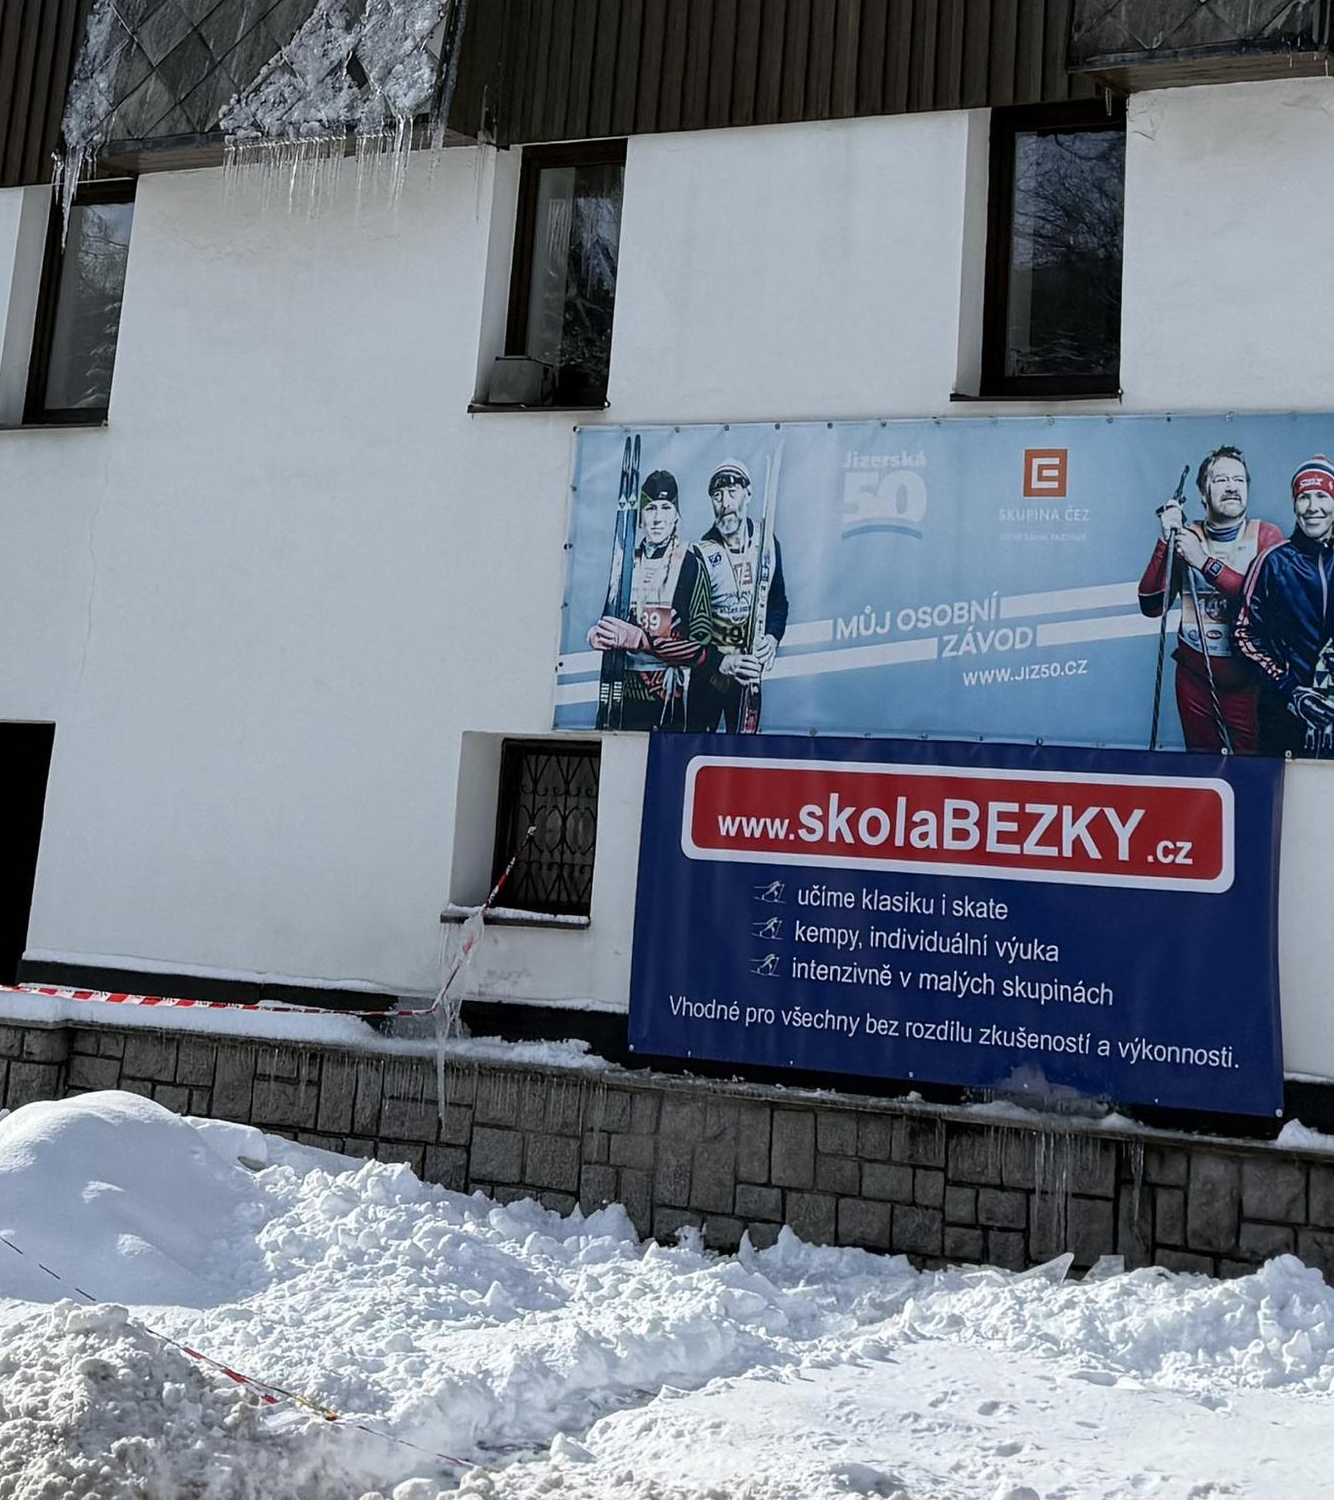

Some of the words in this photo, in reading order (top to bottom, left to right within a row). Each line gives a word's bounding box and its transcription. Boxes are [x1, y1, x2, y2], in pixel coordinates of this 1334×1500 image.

[843, 449, 927, 468] Jizerská
[842, 470, 928, 524] 50
[998, 507, 1060, 522] SKUPINA
[1064, 504, 1091, 522] ČEZ
[835, 605, 892, 640] MŮJ
[897, 591, 1000, 632] OSOBNÍ
[942, 627, 1033, 658] ZÁVOD
[962, 659, 1088, 687] WWW.JIZ50.CZ
[797, 885, 855, 909] učíme
[862, 888, 934, 915] klasiku
[941, 894, 947, 916] i
[952, 894, 1009, 920] skate
[794, 920, 863, 951] kempy,
[869, 926, 988, 957] individuální
[995, 936, 1060, 964] výuka
[791, 957, 893, 986] intenzivně
[899, 970, 912, 988] v
[919, 969, 995, 998] malých
[1002, 975, 1114, 1006] skupinách
[669, 995, 740, 1021] Vhodné
[745, 1006, 776, 1027] pro
[781, 1005, 860, 1037] všechny
[866, 1012, 900, 1037] bez
[905, 1019, 972, 1043] rozdílu
[978, 1024, 1092, 1055] zkušeností
[1097, 1039, 1110, 1057] a
[1118, 1036, 1240, 1069] výkonnosti.
